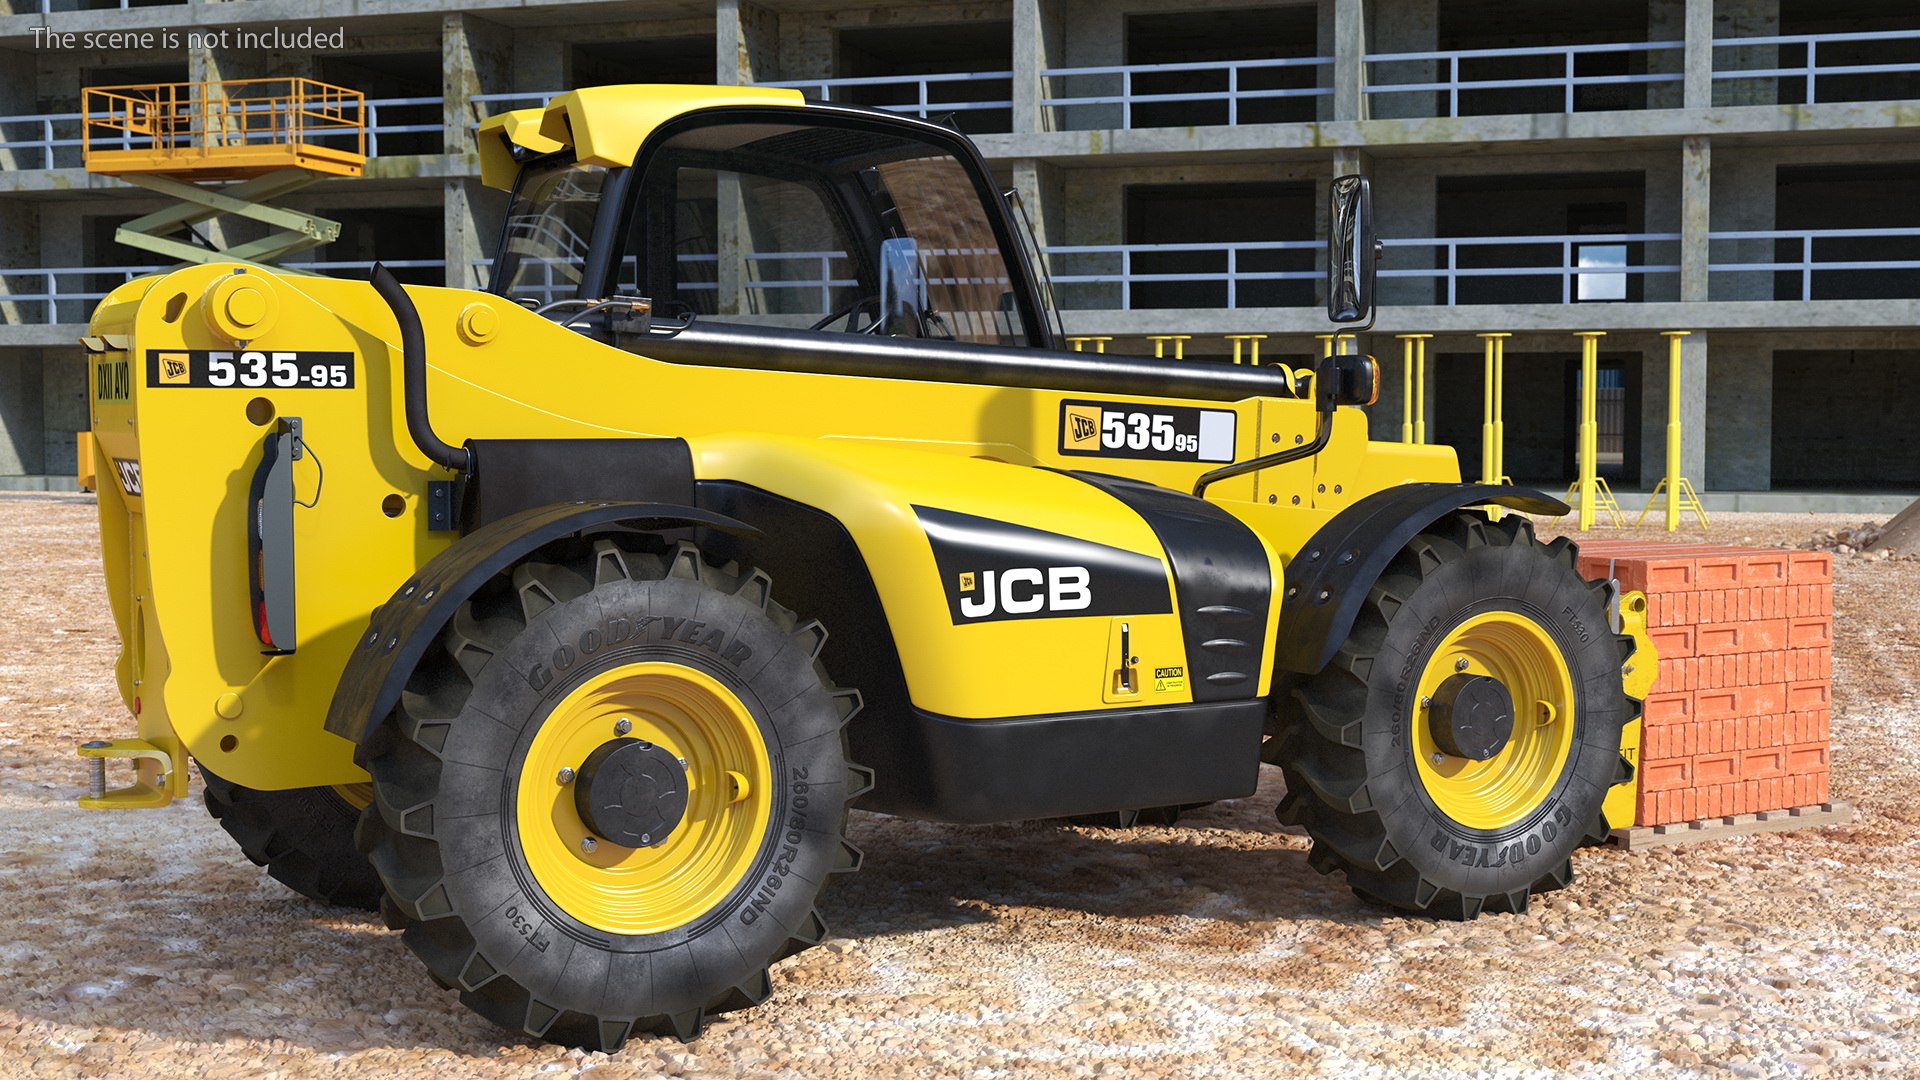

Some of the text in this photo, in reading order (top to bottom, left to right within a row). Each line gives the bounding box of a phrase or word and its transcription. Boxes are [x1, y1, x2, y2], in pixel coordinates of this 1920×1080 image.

[166, 352, 347, 387] JCB 535-95
[1074, 417, 1095, 439] JCB
[960, 566, 1092, 618] JCB
[529, 615, 753, 691] GOODYEAR
[1156, 668, 1182, 677] CAUTION
[1430, 804, 1572, 868] GOODYEAR
[505, 906, 550, 953] FT530
